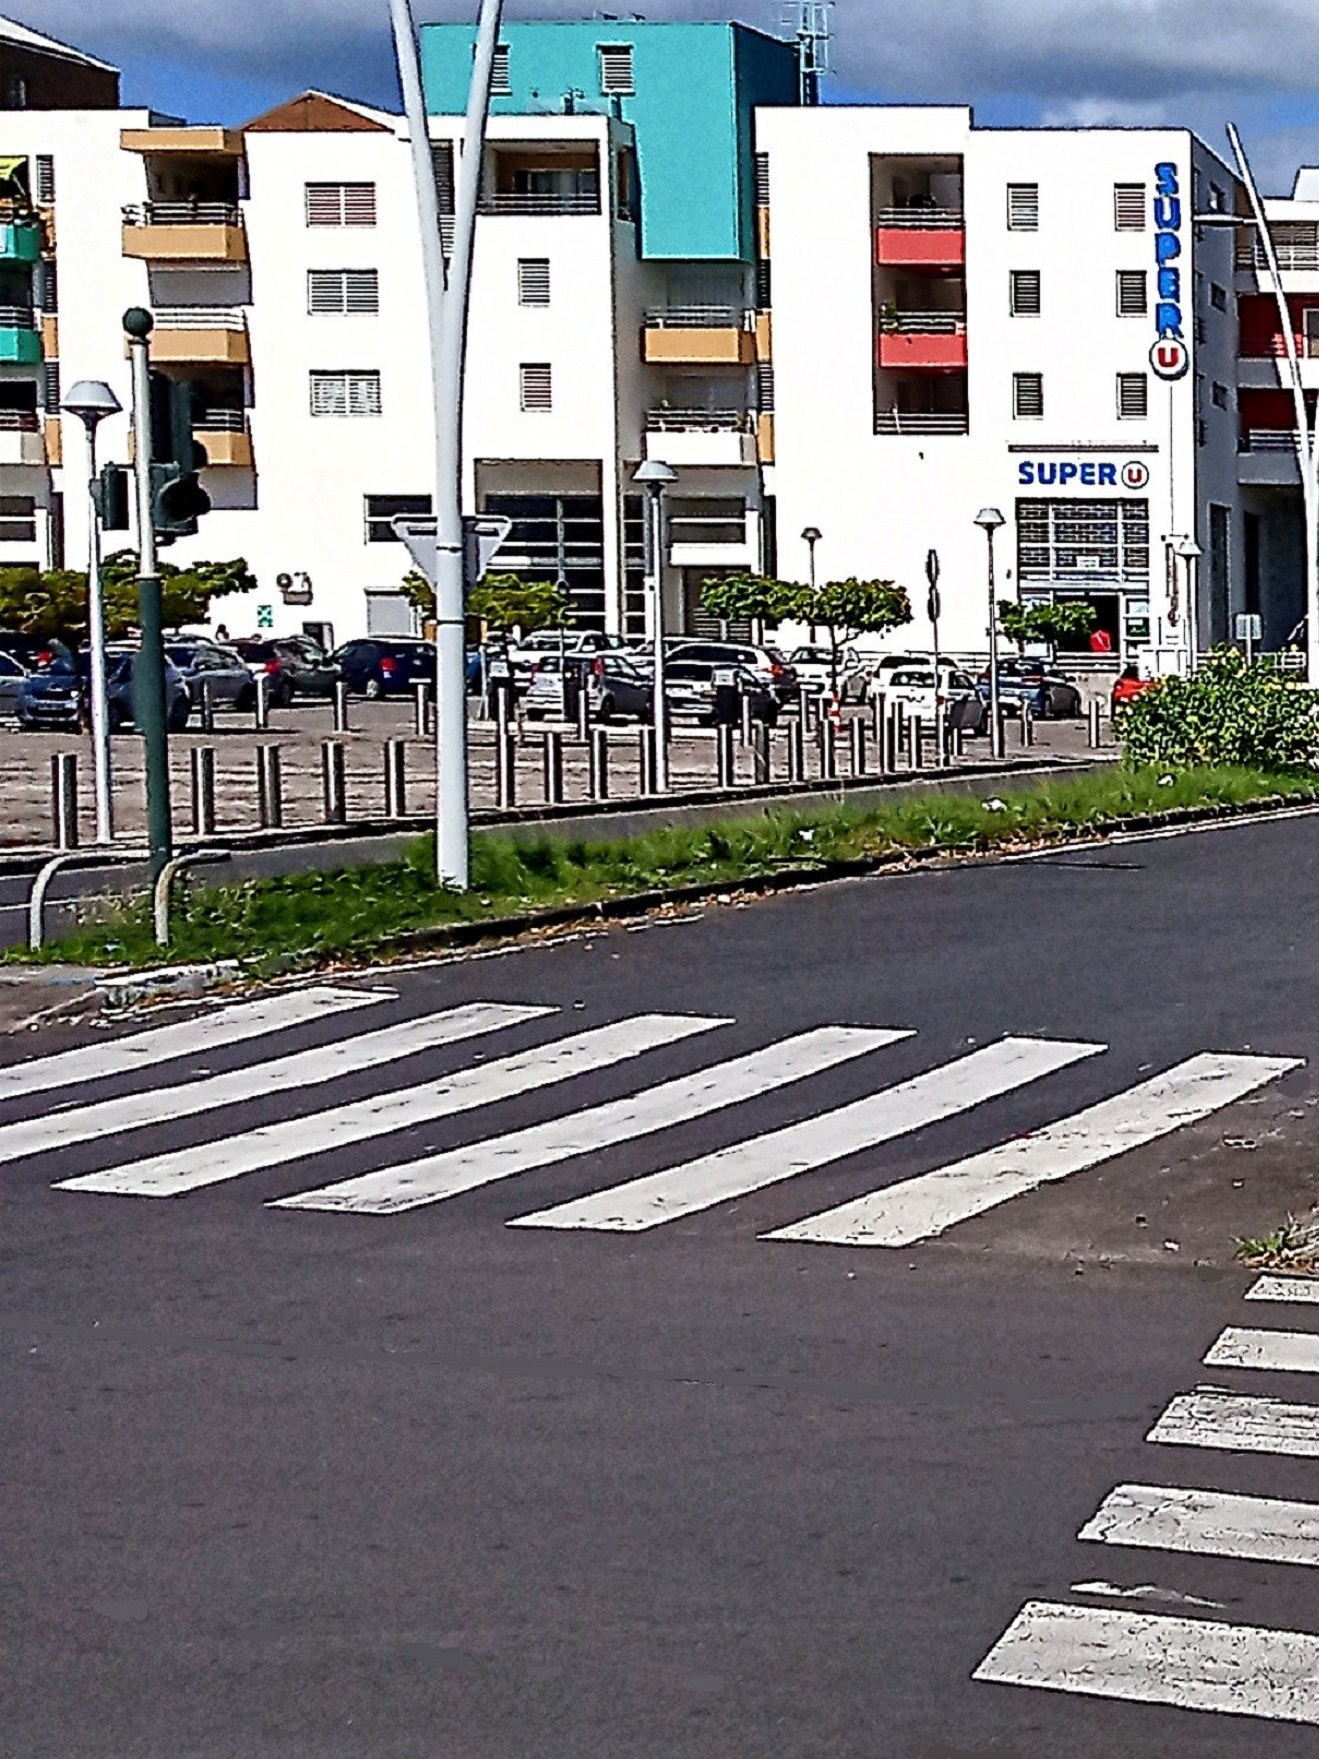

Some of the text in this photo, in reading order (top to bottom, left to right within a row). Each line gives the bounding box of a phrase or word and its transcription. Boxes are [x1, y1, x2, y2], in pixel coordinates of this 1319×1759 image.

[1153, 162, 1184, 368] SUPER U
[1018, 461, 1143, 486] SUPER U
